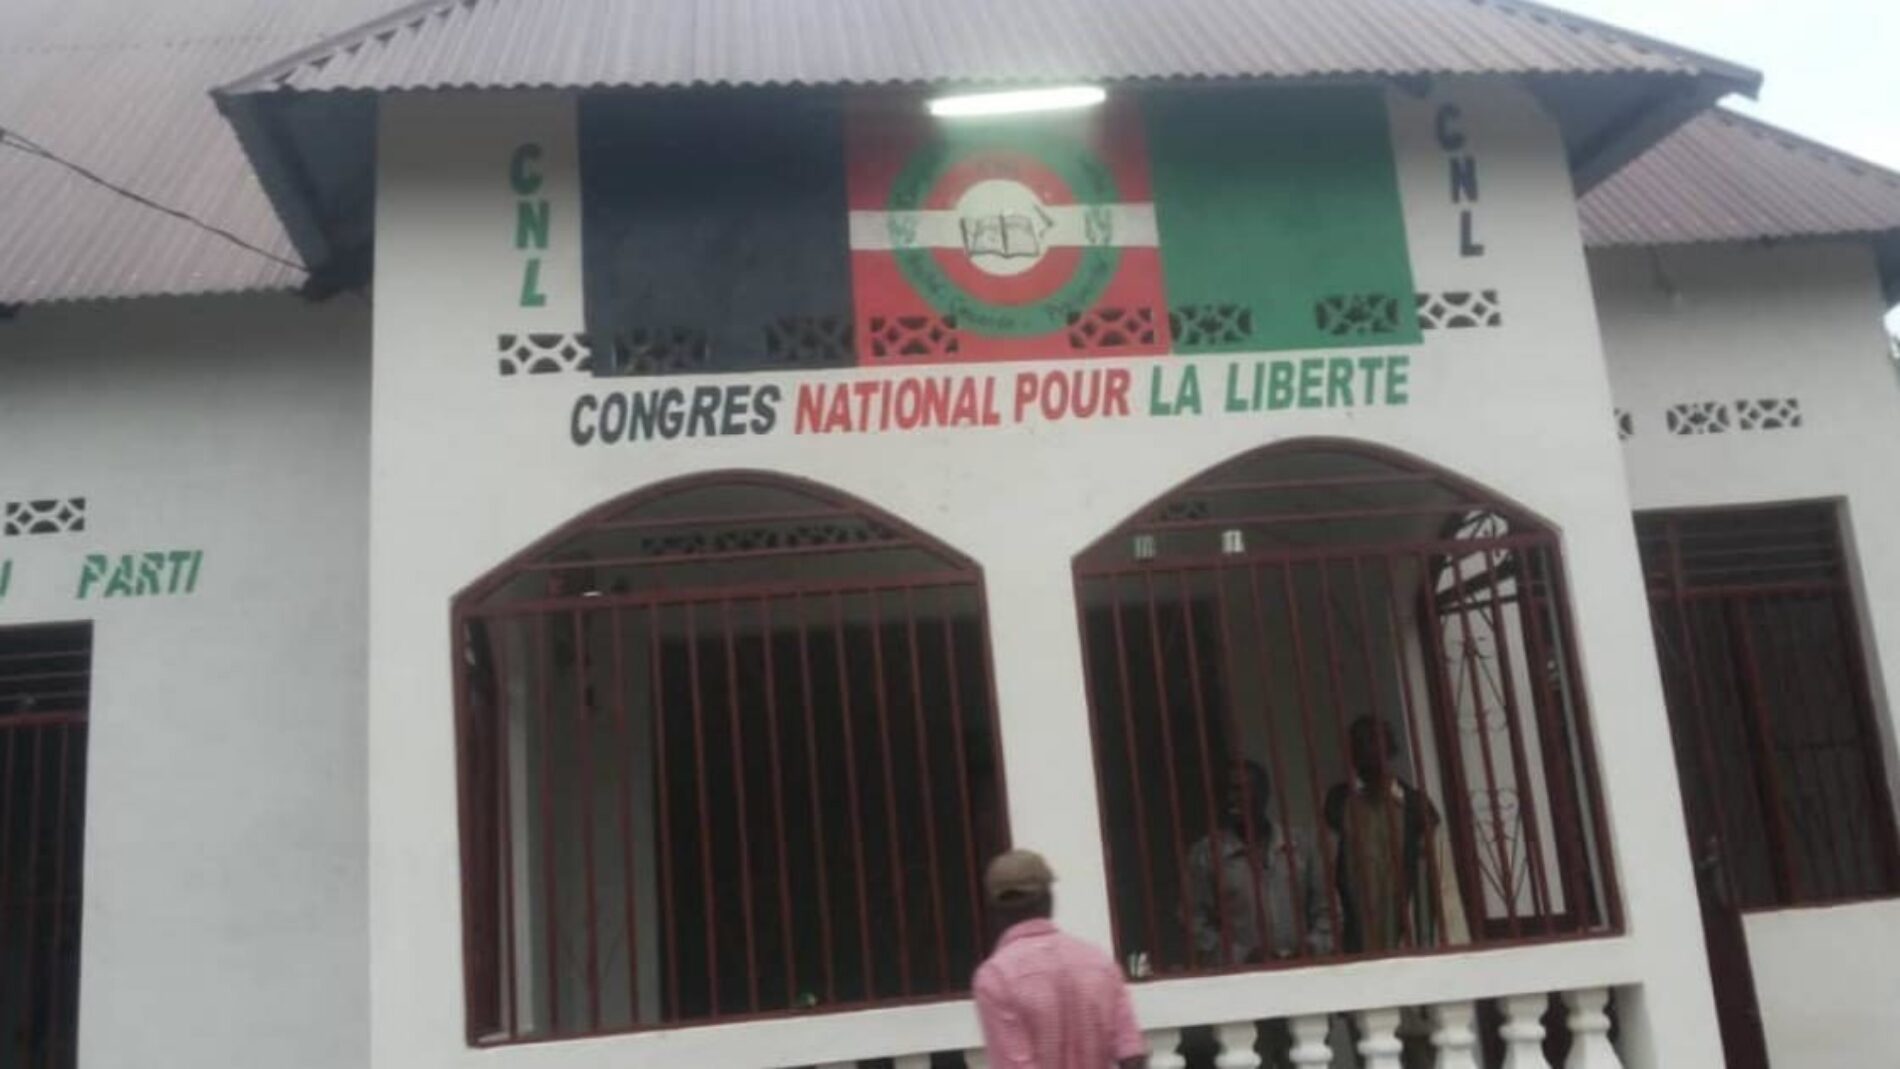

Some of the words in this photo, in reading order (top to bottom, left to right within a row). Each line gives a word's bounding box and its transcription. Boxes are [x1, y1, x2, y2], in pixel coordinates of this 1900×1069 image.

[509, 143, 550, 307] CNL
[1436, 103, 1485, 257] CNL
[570, 384, 780, 446] CONGRES
[794, 376, 1000, 436] NATIONAL
[1014, 368, 1131, 424] POUR
[1149, 364, 1202, 417] LA
[1225, 355, 1410, 413] LIBERTE
[77, 549, 204, 600] PARTI
